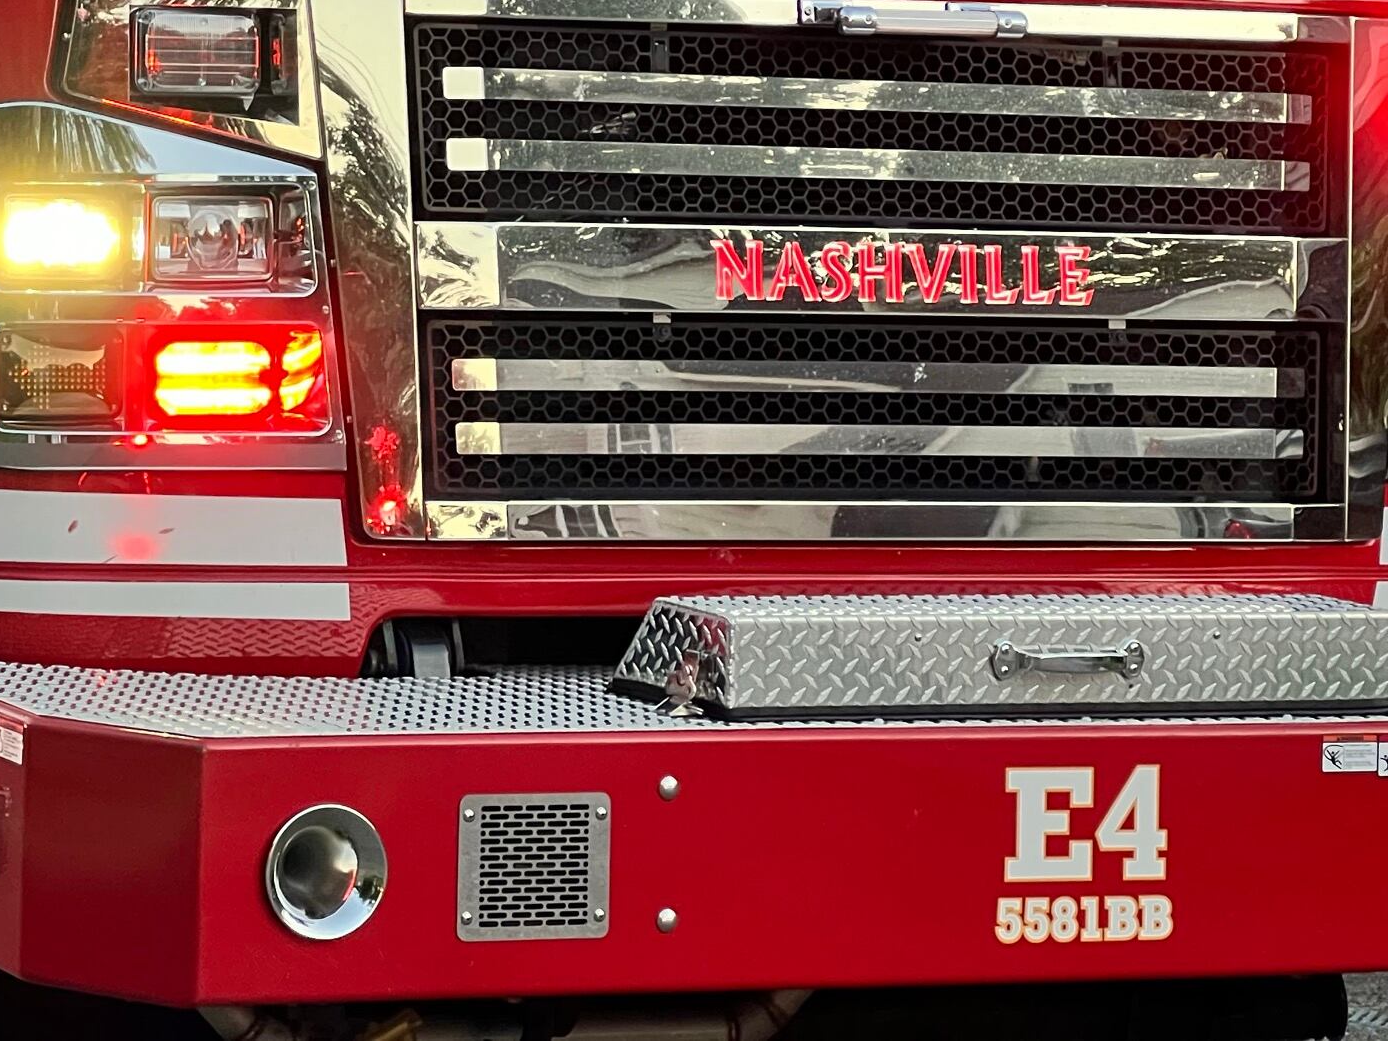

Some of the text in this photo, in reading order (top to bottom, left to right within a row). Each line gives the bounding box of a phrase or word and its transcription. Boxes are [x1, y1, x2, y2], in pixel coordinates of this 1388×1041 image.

[710, 239, 1095, 306] NASHVILLE
[1004, 764, 1168, 882] E4
[995, 895, 1173, 944] 5581BB
